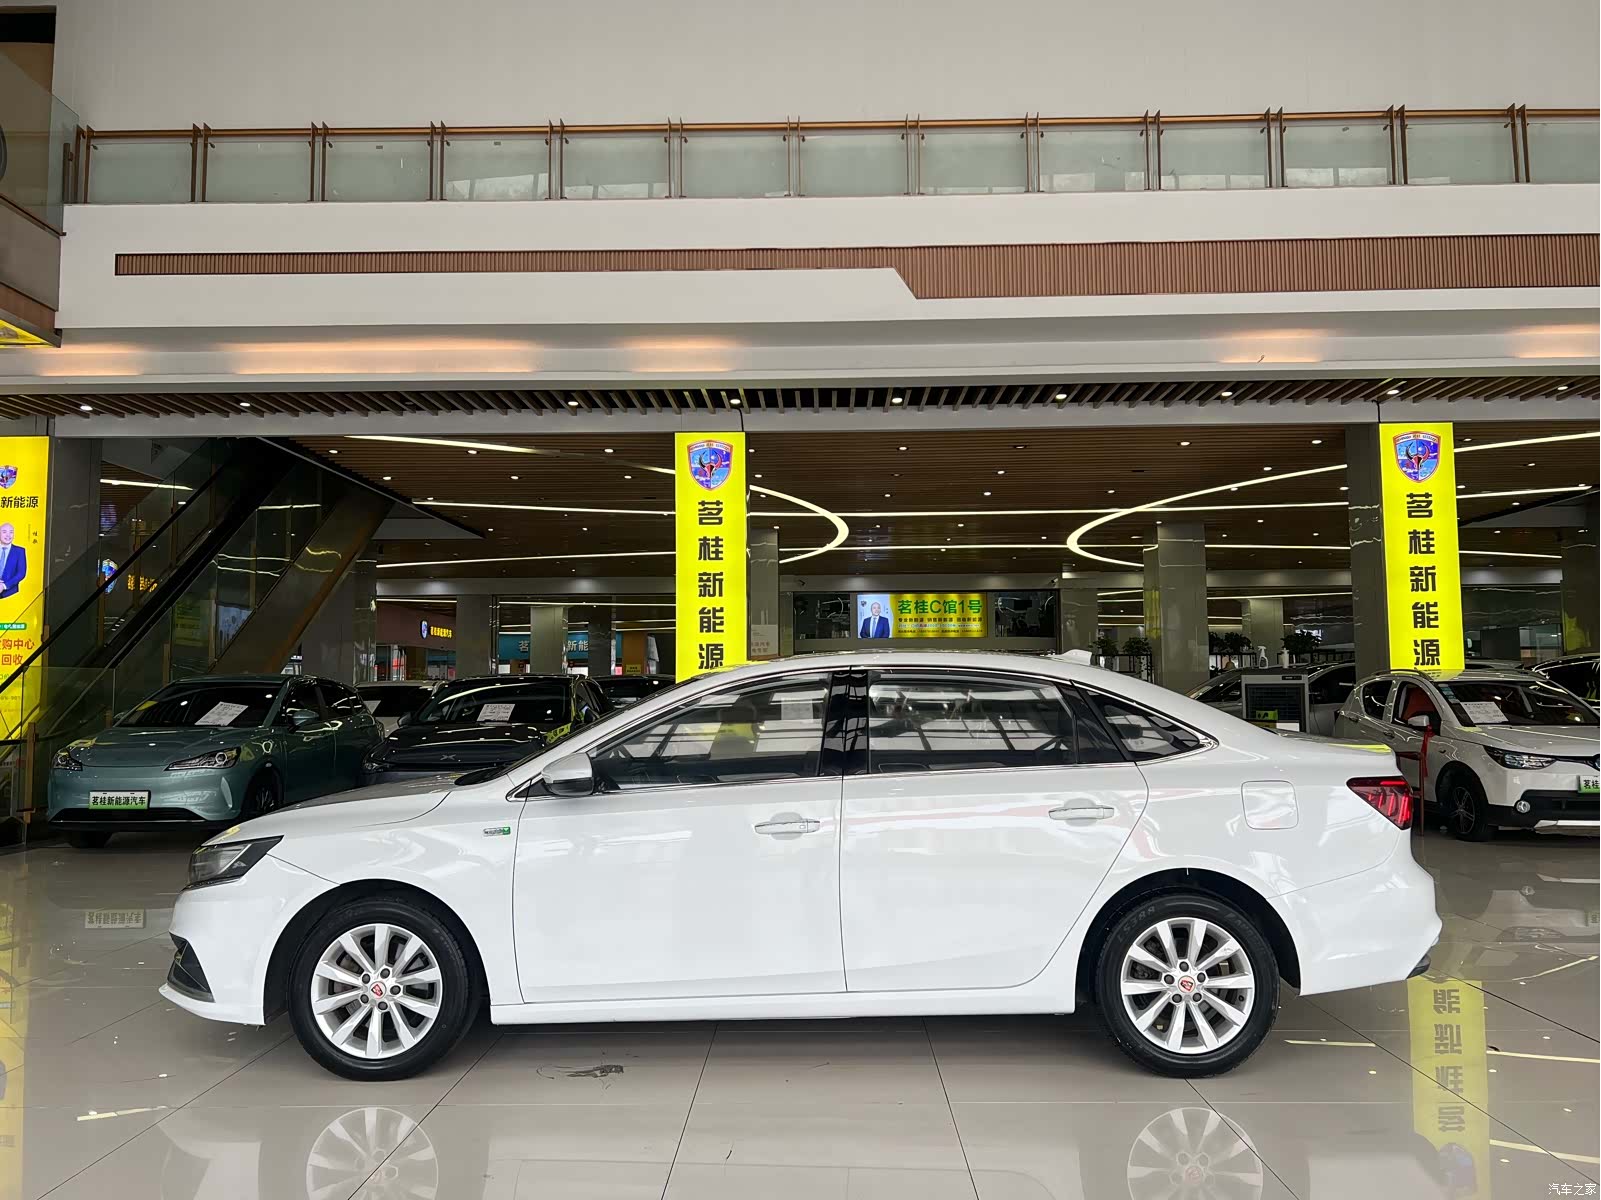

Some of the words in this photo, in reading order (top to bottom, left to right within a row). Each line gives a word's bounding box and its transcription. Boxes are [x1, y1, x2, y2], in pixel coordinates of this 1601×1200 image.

[1, 496, 39, 509] 新能源
[698, 500, 725, 670] 茗桂新能源
[1406, 492, 1441, 666] 茗桂新能源
[898, 599, 983, 614] 茗桂C馆1号
[0, 638, 35, 650] 购中心
[2, 654, 24, 666] 回收
[92, 795, 146, 806] 茗桂新能源汽车
